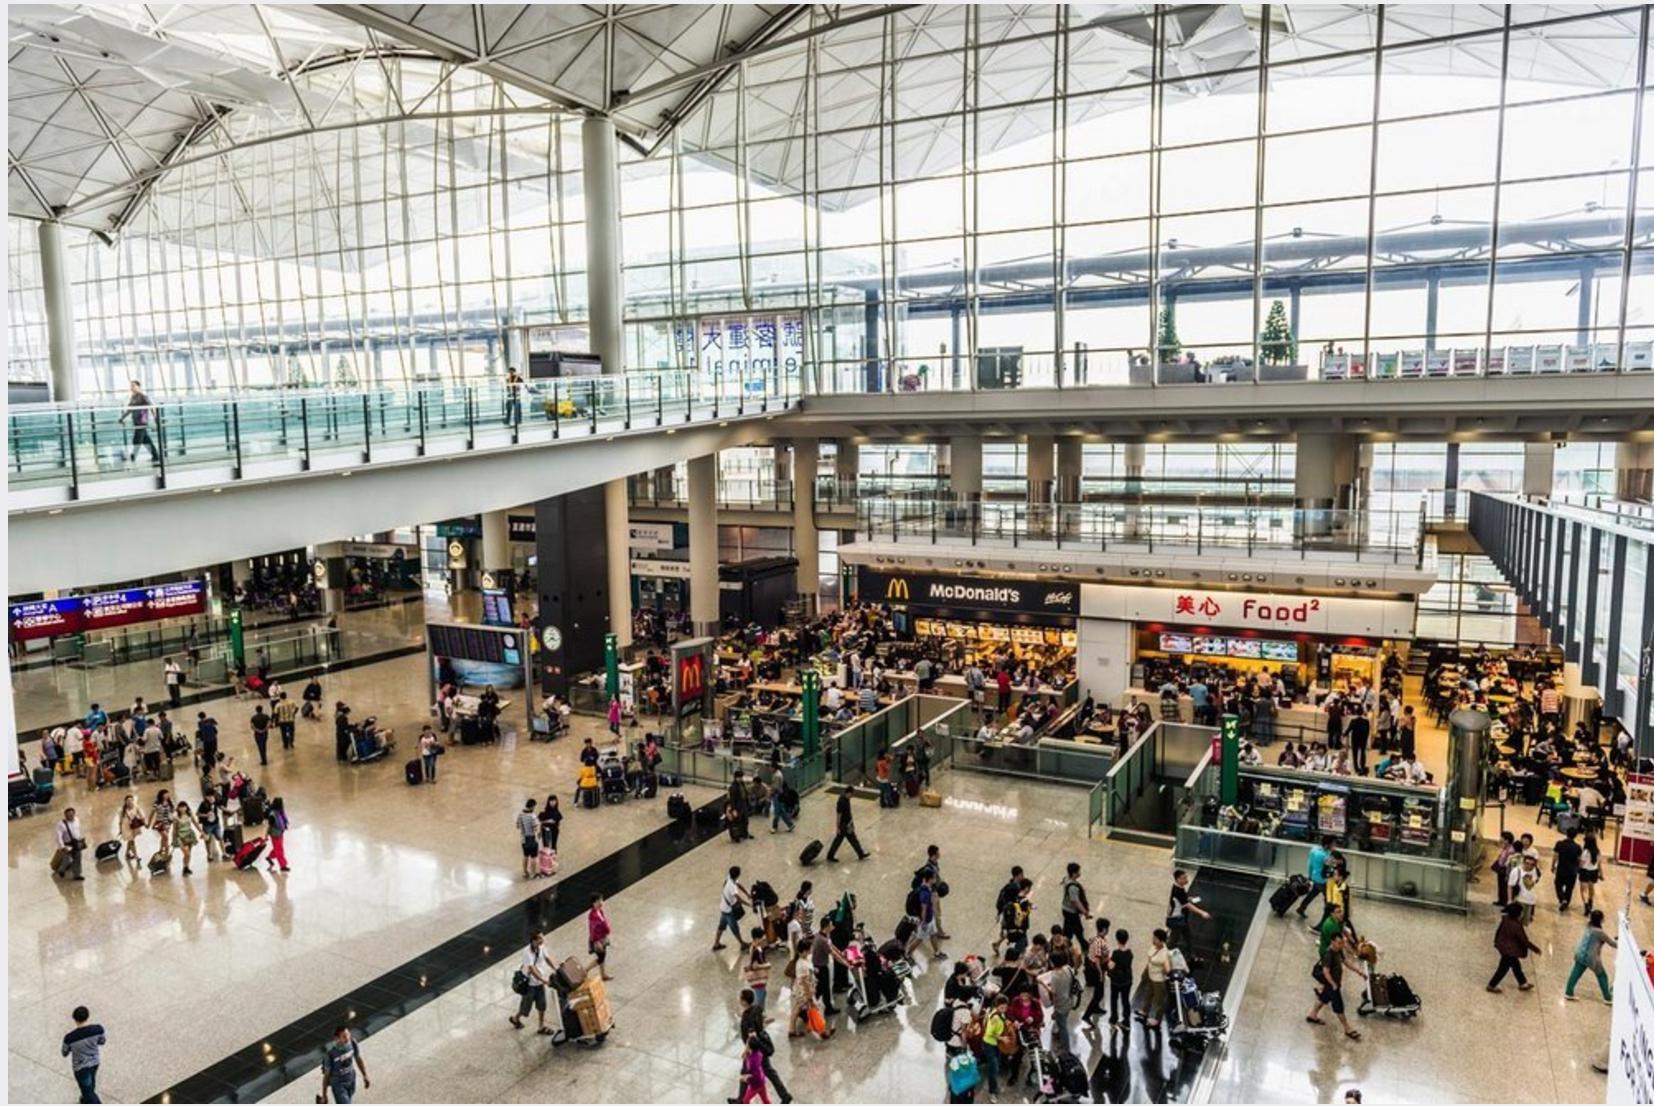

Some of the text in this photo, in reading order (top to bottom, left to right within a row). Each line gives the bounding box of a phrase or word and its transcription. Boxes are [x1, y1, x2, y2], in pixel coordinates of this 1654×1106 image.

[929, 583, 1020, 604] McDonald's
[48, 603, 58, 613] A
[1175, 594, 1221, 617] 美心
